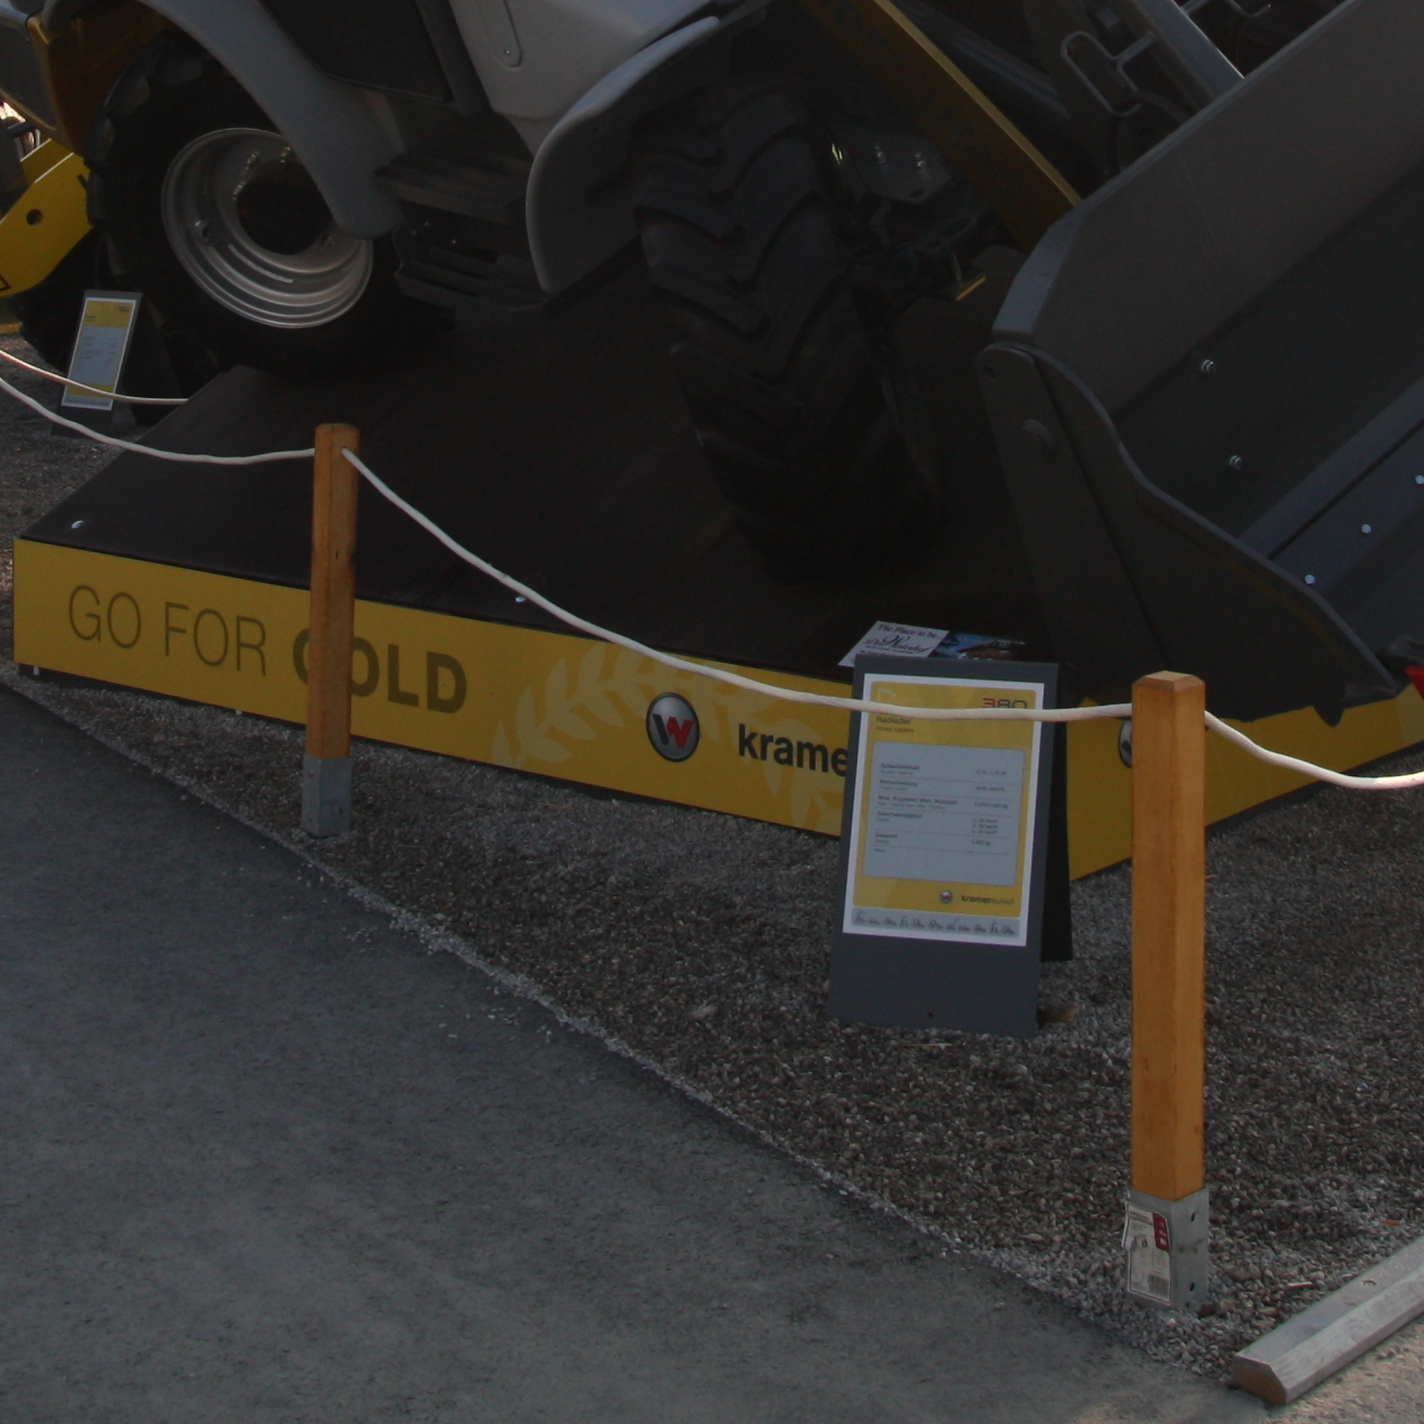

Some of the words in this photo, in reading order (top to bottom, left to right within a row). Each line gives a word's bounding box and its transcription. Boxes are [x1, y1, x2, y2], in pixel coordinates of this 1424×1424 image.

[66, 584, 143, 651] GO
[164, 602, 267, 677] FOR
[737, 722, 849, 777] krame
